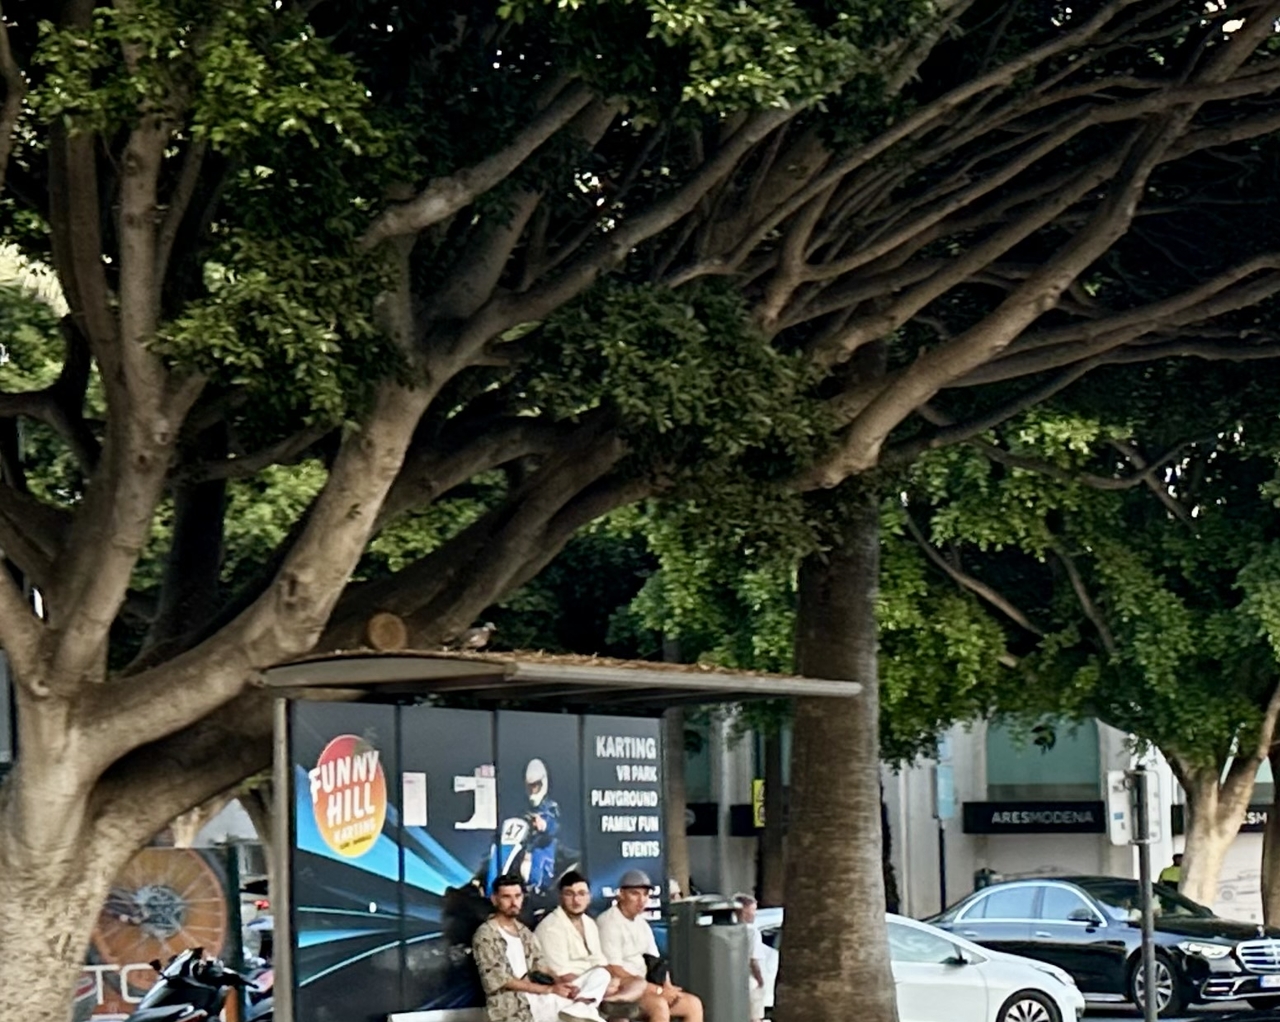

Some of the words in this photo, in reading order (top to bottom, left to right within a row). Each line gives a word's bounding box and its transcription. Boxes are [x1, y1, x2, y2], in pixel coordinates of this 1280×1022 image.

[596, 736, 656, 759] KARTING
[308, 750, 379, 804] FUNNY
[616, 765, 631, 782] VR
[632, 766, 657, 782] PARK
[327, 782, 375, 828] HILL
[592, 790, 658, 807] PLAYGROUND
[602, 815, 637, 832] FAMILY
[638, 816, 659, 832] FUN
[622, 841, 660, 858] EVENTS
